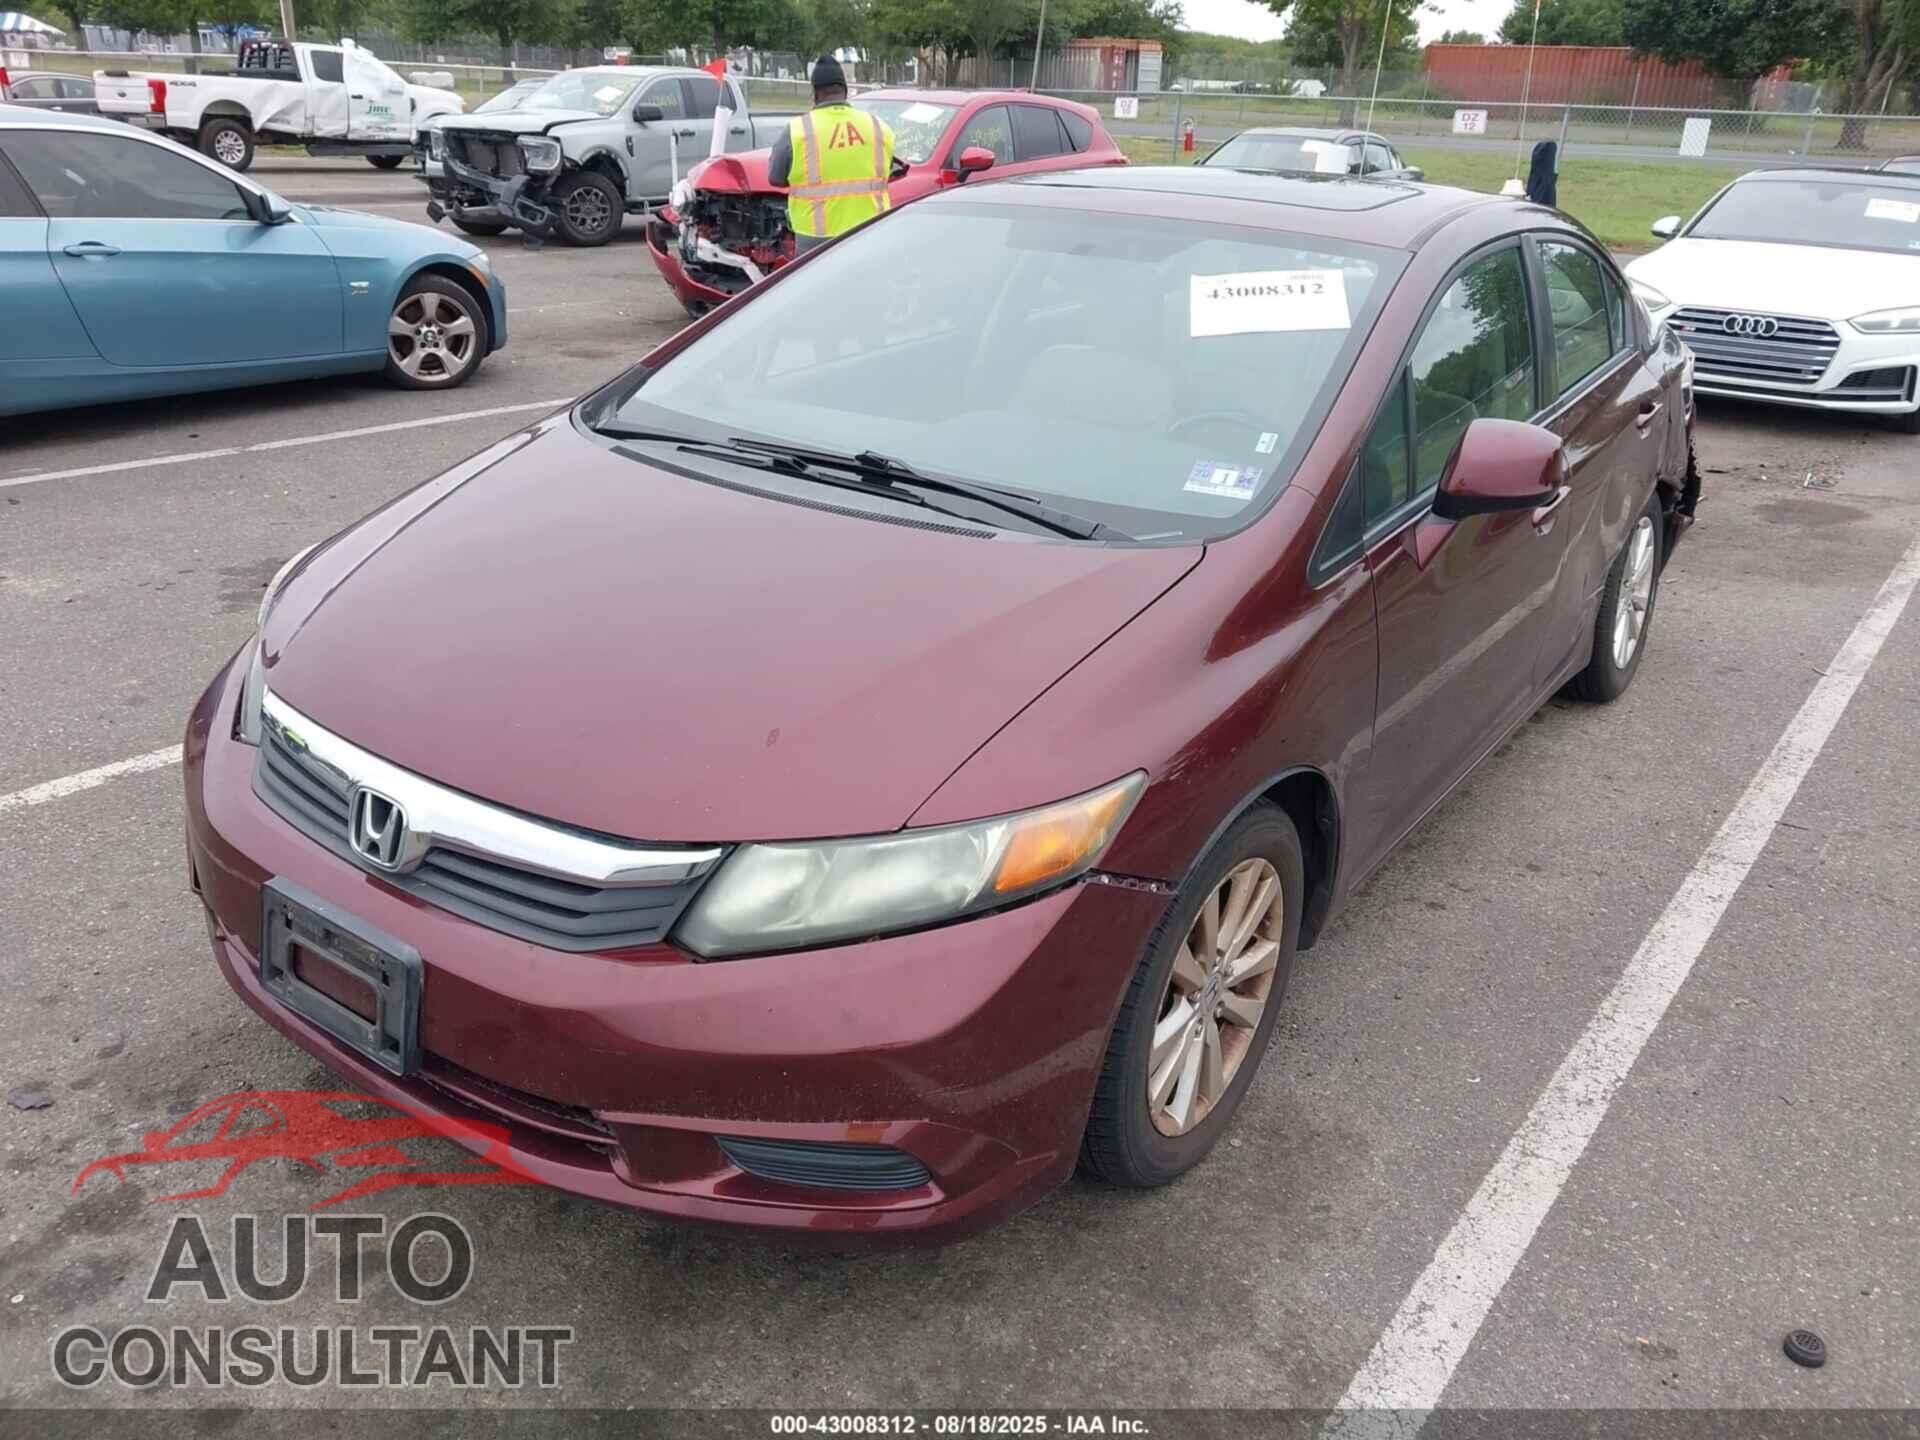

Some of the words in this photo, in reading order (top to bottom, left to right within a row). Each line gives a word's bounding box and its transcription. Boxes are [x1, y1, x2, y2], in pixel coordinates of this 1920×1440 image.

[1462, 113, 1479, 121] DZ
[1464, 122, 1477, 130] 12
[1206, 283, 1324, 300] 43008312
